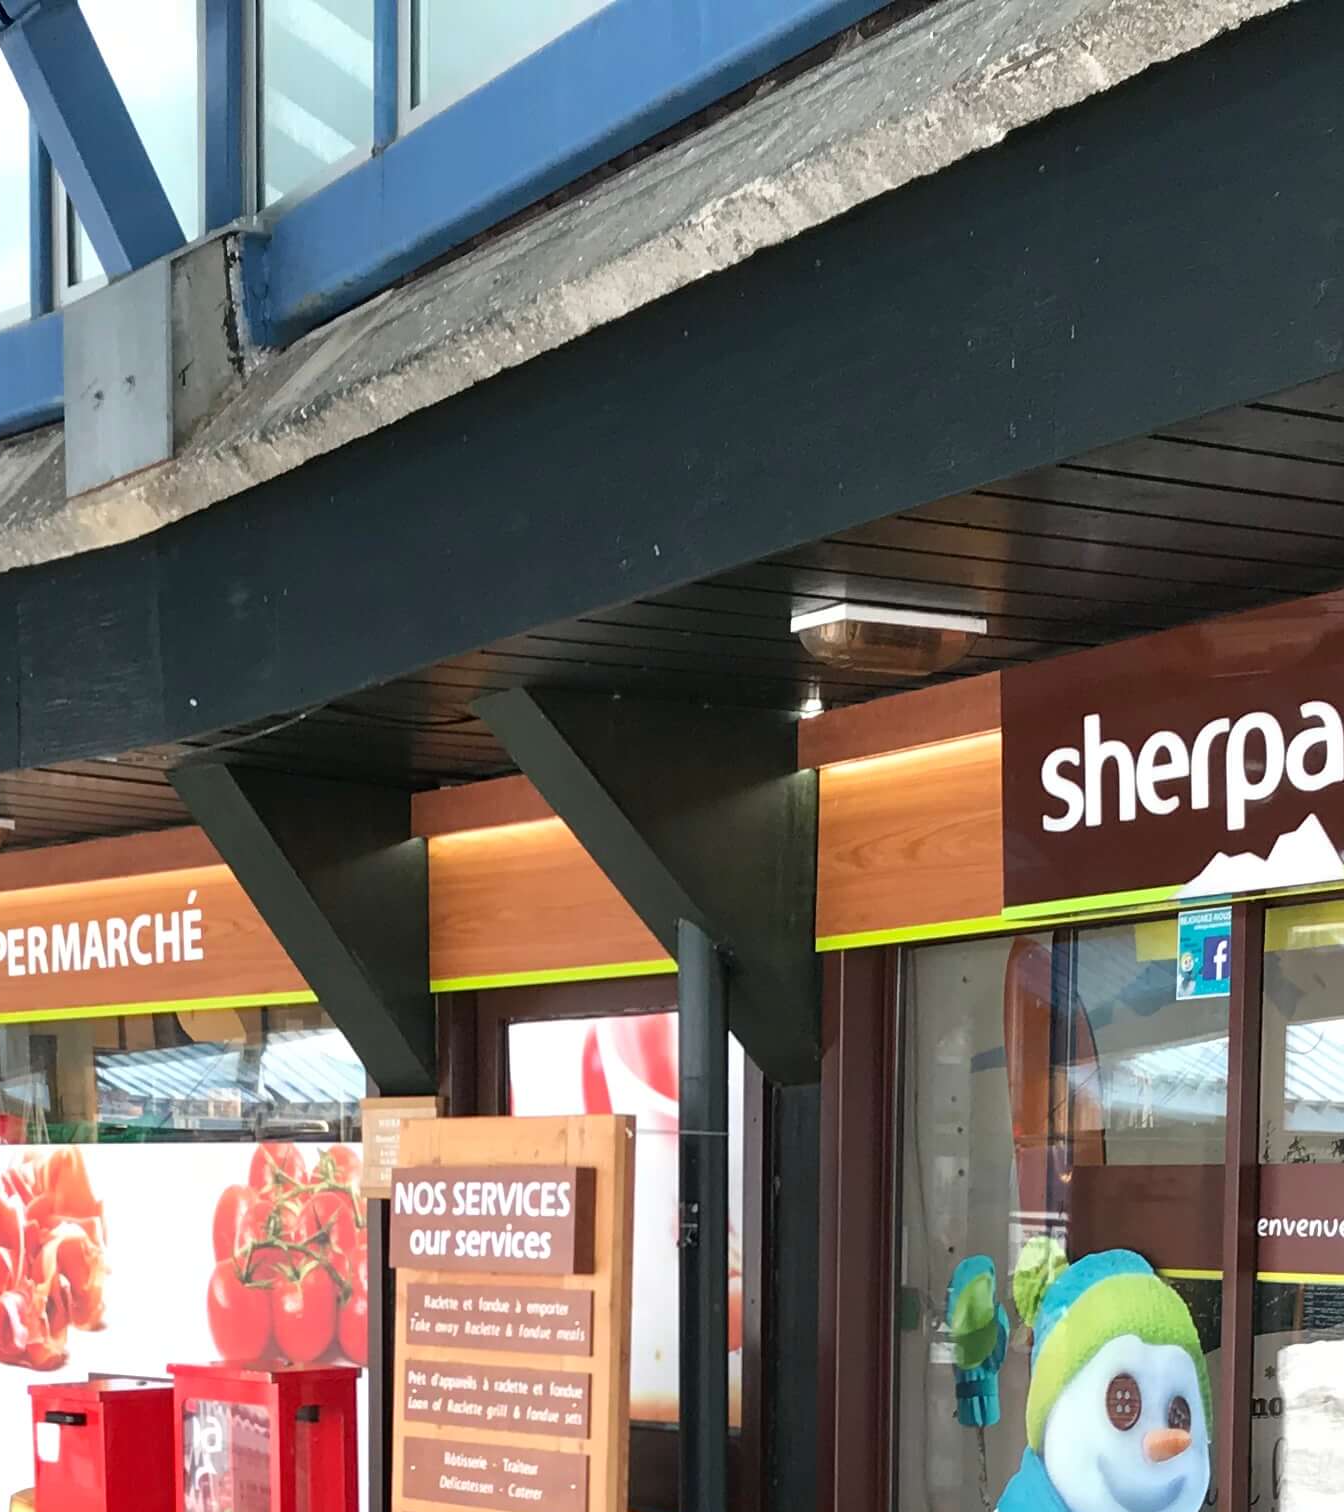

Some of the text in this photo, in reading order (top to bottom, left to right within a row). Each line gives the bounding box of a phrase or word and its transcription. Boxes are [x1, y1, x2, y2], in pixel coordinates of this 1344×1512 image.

[394, 1181, 571, 1217] NOS SERVICES
[410, 1223, 552, 1259] our services
[424, 1295, 459, 1312] Raclette
[463, 1298, 473, 1311] et
[479, 1297, 510, 1313] fondue
[527, 1303, 569, 1318] emporter
[410, 1318, 430, 1332] Take
[435, 1322, 459, 1337] away
[464, 1322, 501, 1337] Raclette
[519, 1324, 552, 1340] fondue
[556, 1327, 585, 1342] meals
[533, 1382, 544, 1396] et
[550, 1382, 583, 1399] fondue
[526, 1406, 559, 1424] fondue
[503, 1458, 539, 1475] Traiteur
[508, 1484, 543, 1500] Caterer
